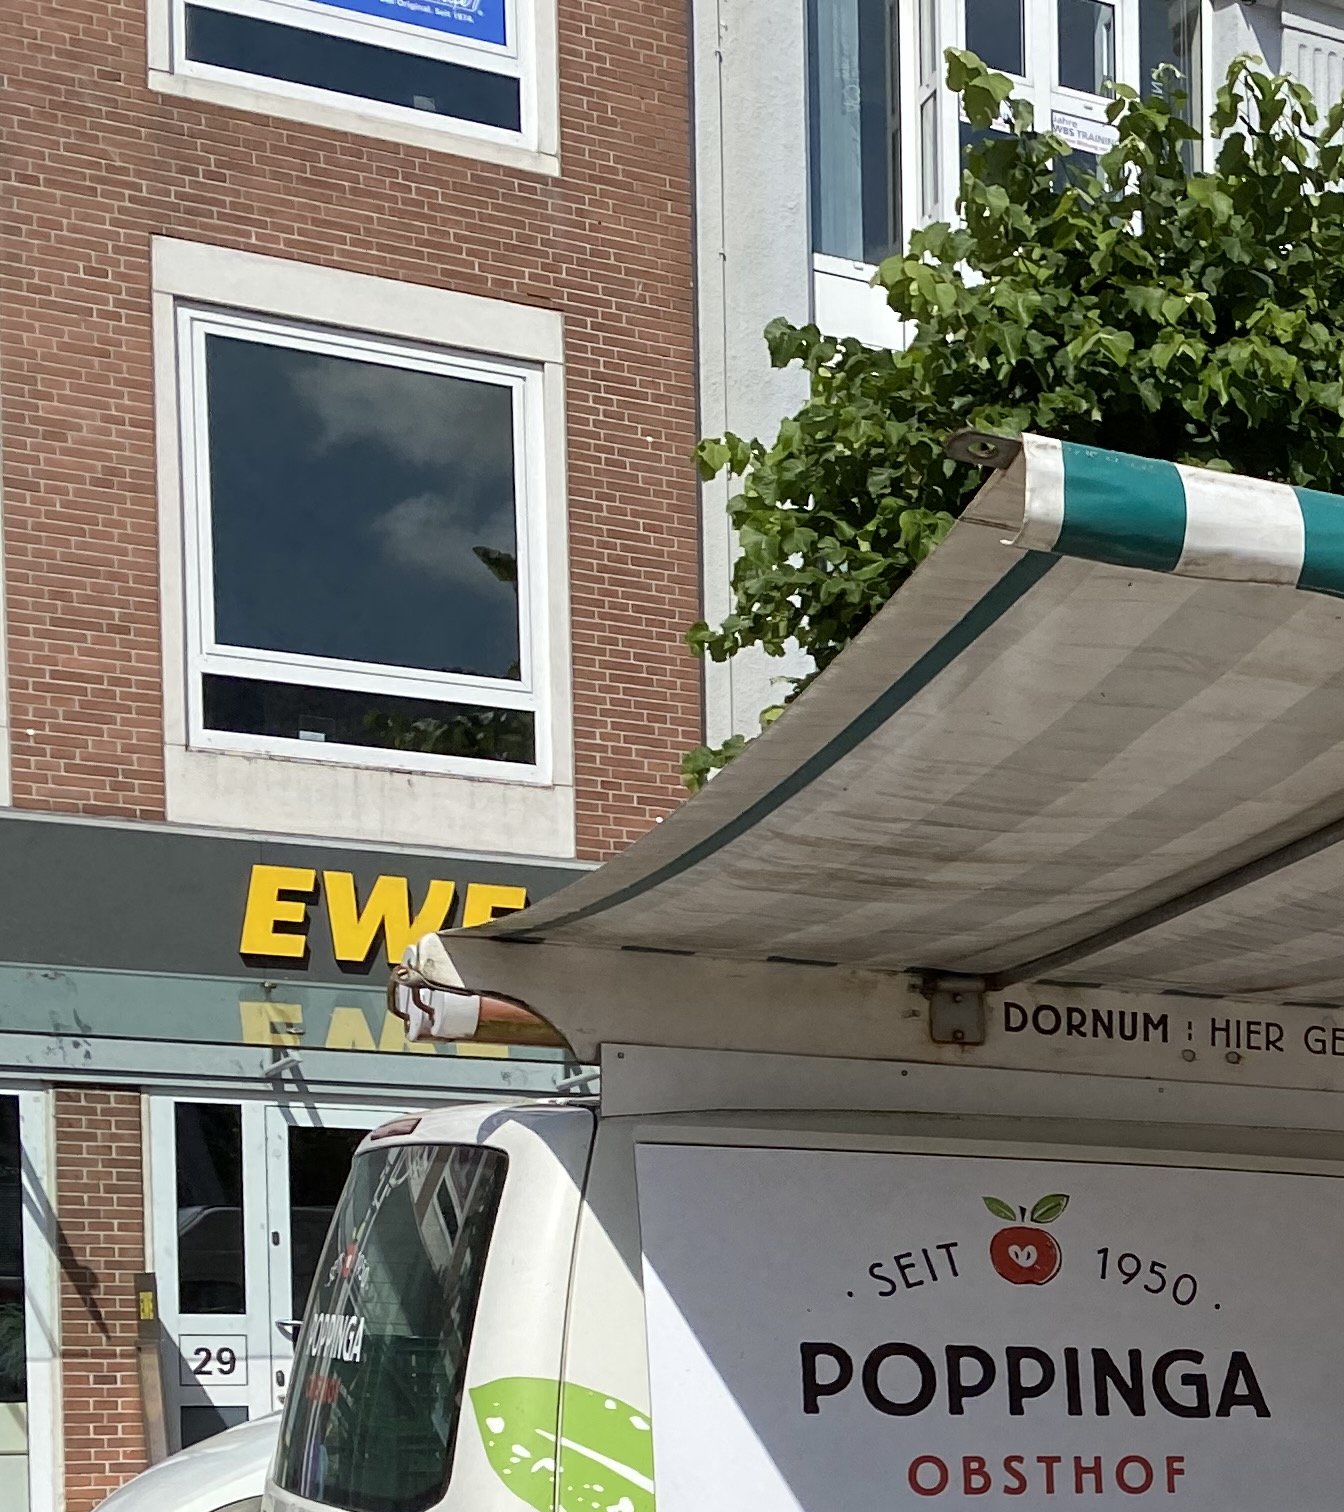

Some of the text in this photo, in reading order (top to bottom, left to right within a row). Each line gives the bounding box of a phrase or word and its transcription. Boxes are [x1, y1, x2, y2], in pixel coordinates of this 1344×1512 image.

[1003, 1001, 1170, 1044] DORNUM
[1211, 1017, 1285, 1053] HIER
[868, 1241, 1199, 1307] SEIT 1950
[193, 1347, 237, 1376] 29
[799, 1341, 1272, 1419] POPPINGA
[907, 1453, 1188, 1497] OBSTHOF
